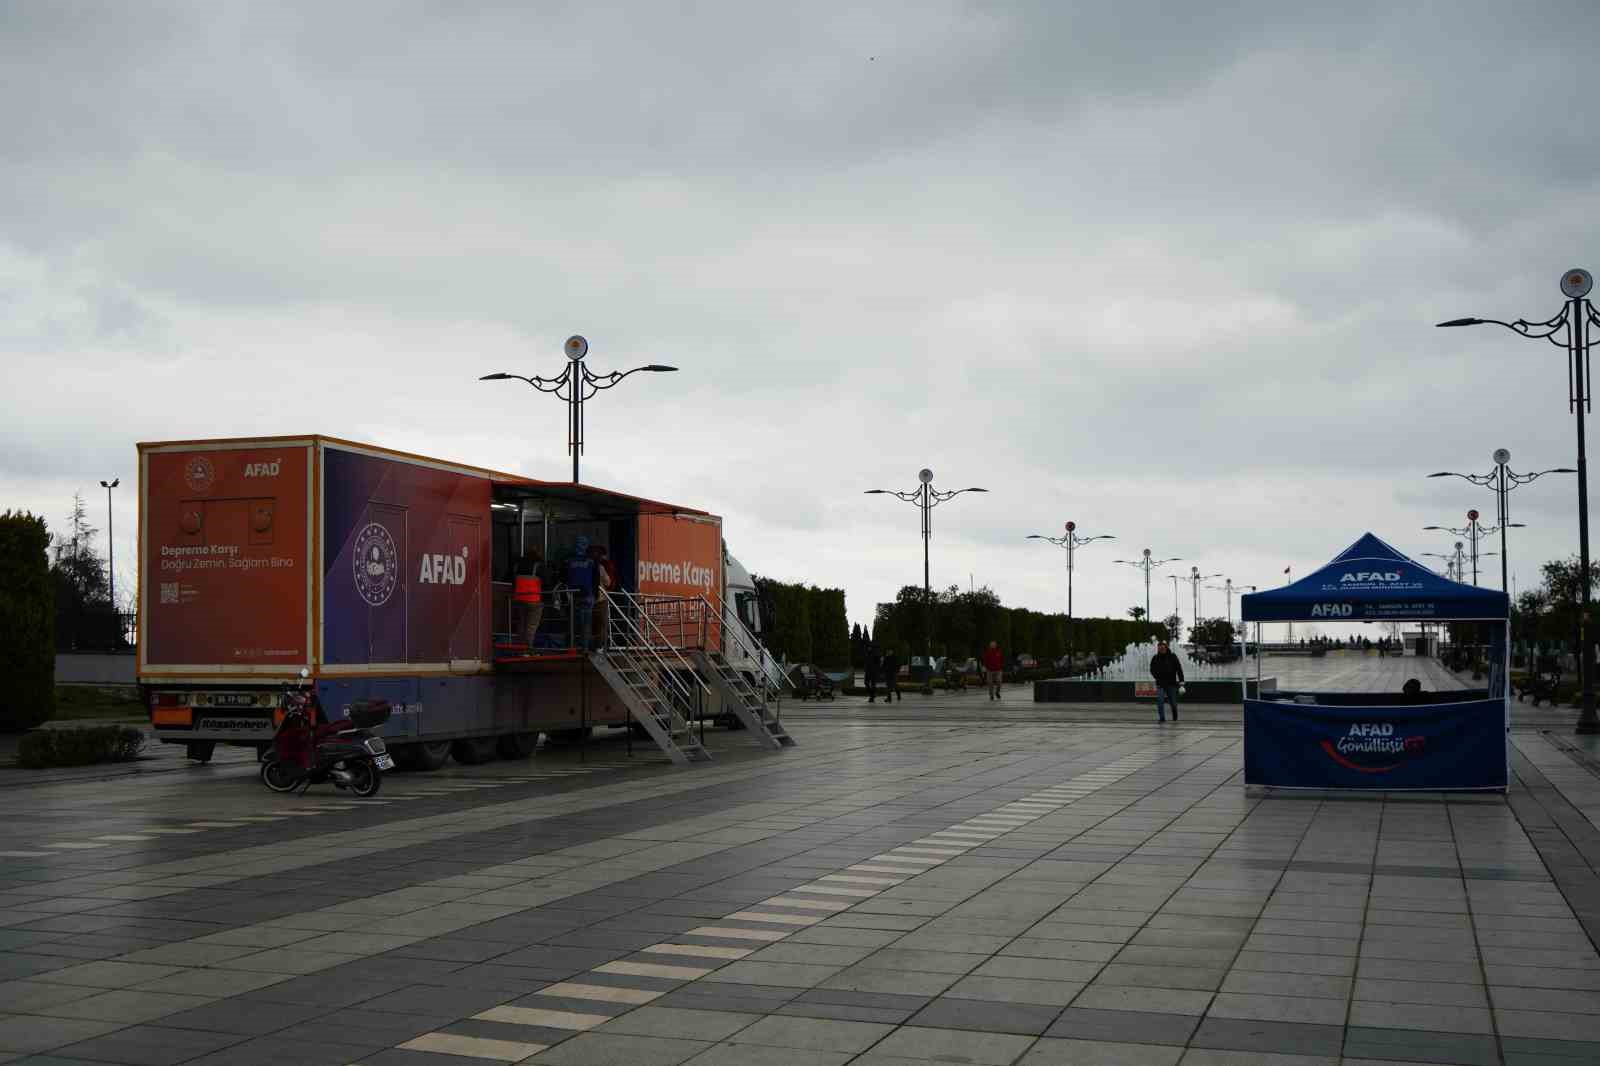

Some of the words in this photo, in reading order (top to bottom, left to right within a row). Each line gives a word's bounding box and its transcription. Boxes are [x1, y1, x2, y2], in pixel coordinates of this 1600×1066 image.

[244, 462, 280, 477] AFAD
[419, 553, 466, 585] AFAD
[683, 559, 714, 595] Karşı
[1340, 572, 1400, 582] AFAD
[1311, 603, 1352, 616] AFAD
[1349, 723, 1393, 737] AFAD
